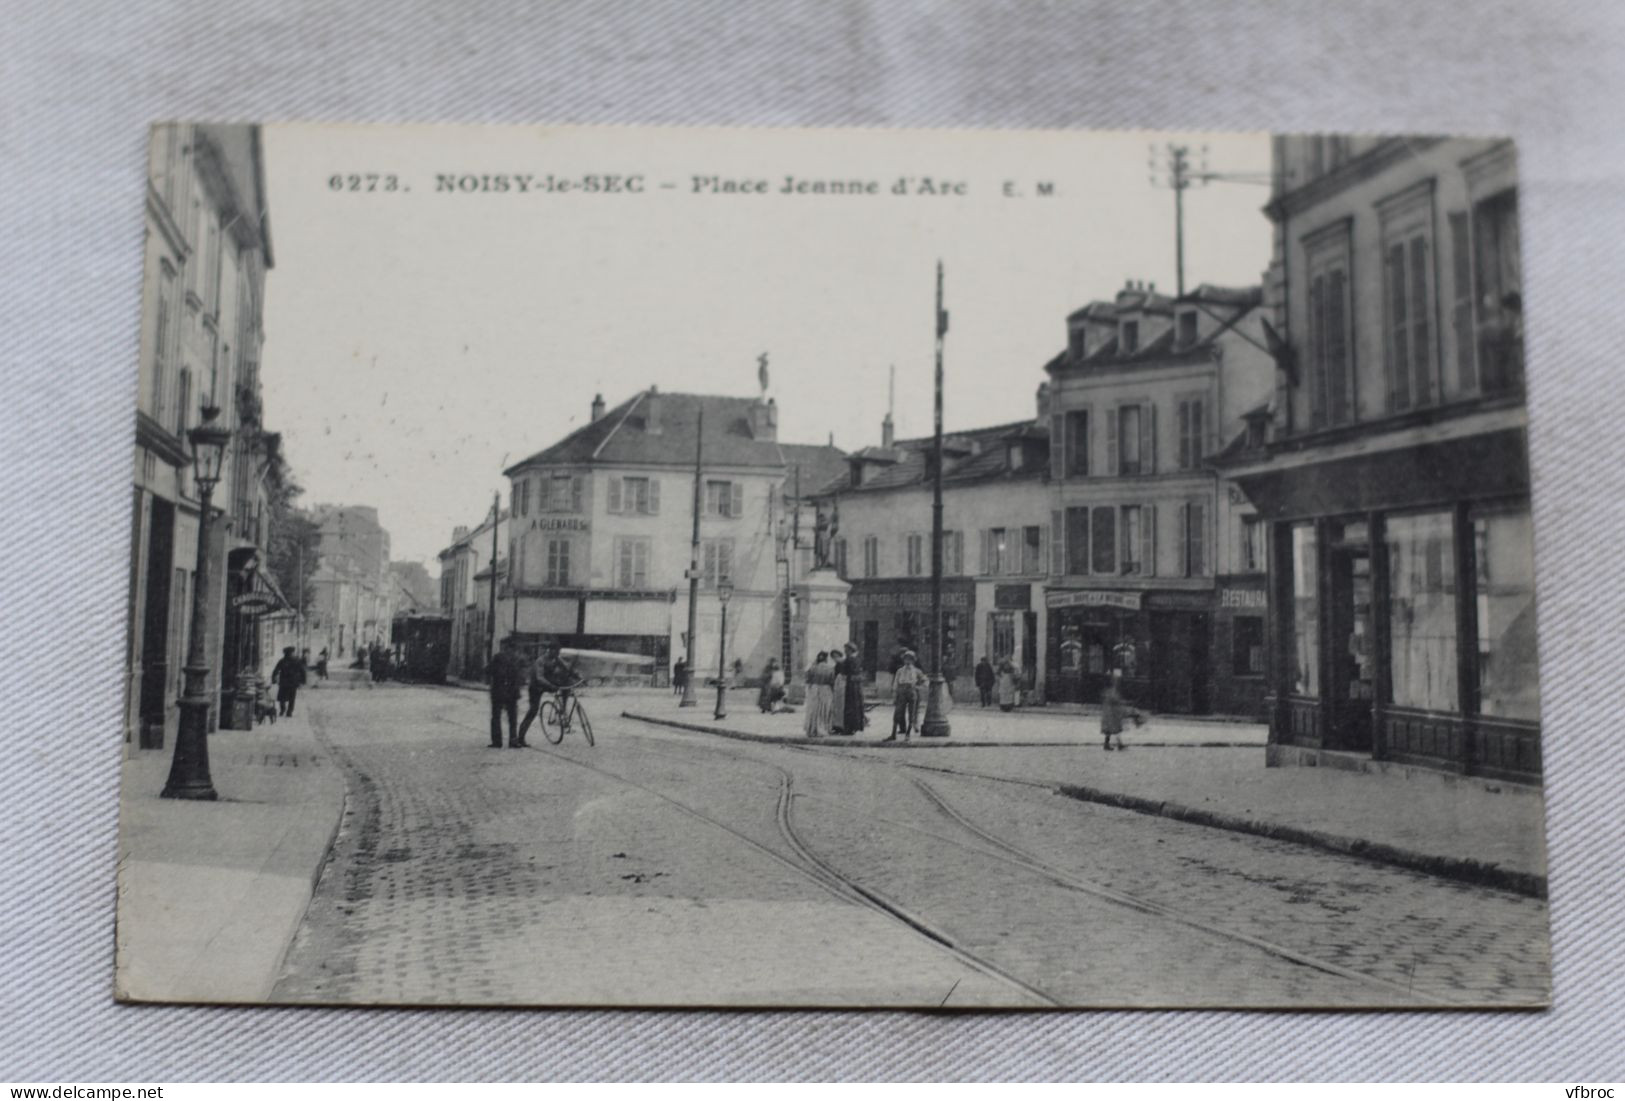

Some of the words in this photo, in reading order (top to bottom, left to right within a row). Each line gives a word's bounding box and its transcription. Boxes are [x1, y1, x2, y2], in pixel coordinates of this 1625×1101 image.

[328, 172, 412, 195] 6273.
[434, 172, 646, 194] NOISY-le-SEC
[690, 174, 769, 195] Place
[779, 174, 879, 195] Jeanne
[890, 176, 967, 196] d'Arc
[1002, 180, 1023, 198] E.
